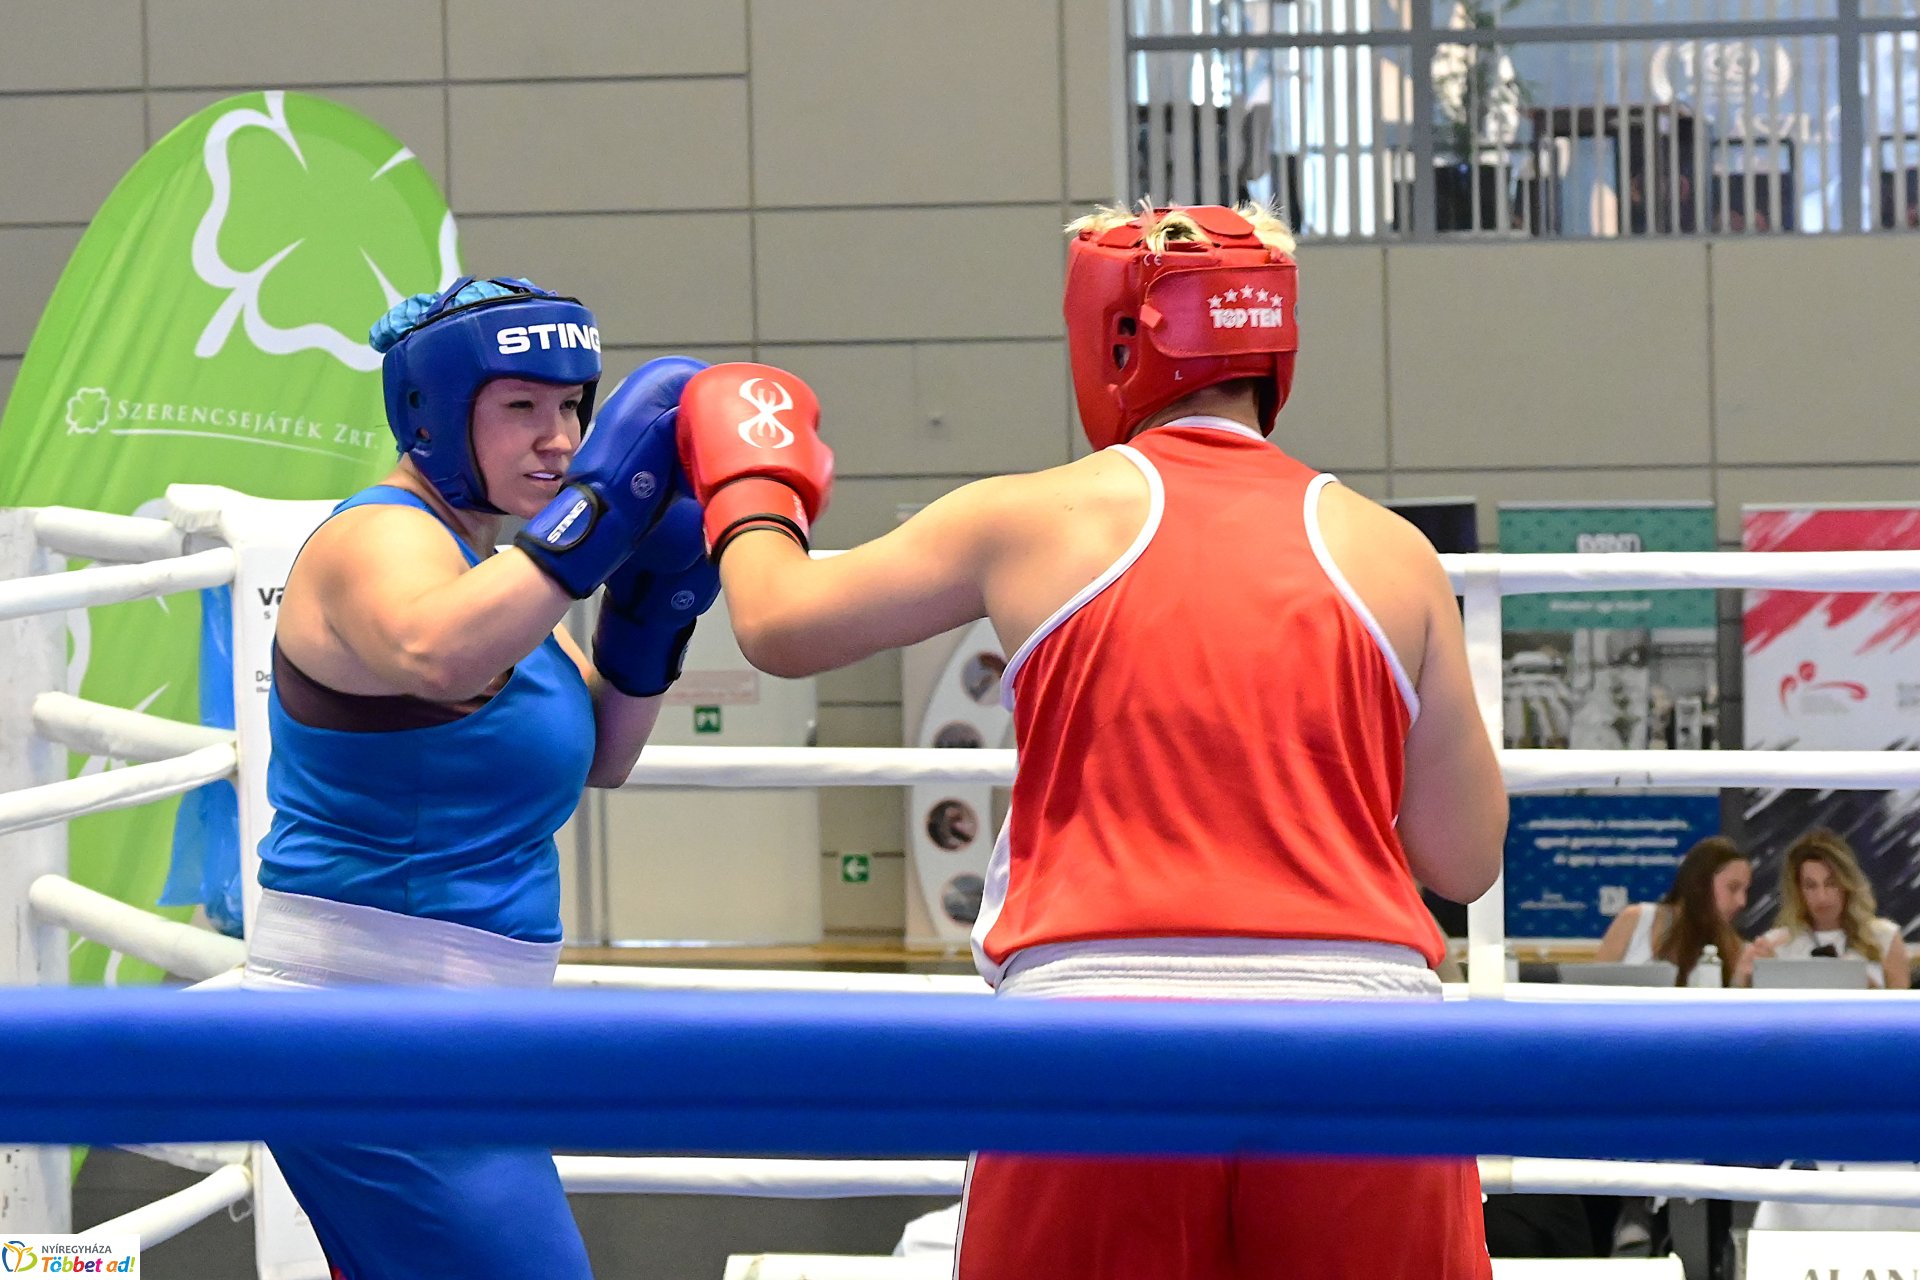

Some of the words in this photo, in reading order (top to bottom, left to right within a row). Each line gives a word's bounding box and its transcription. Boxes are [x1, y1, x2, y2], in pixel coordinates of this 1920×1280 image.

[1209, 307, 1248, 328] TOP
[1248, 306, 1283, 328] TEN
[117, 400, 322, 439] SZERENCSEJÁTÉK
[547, 499, 588, 543] STING
